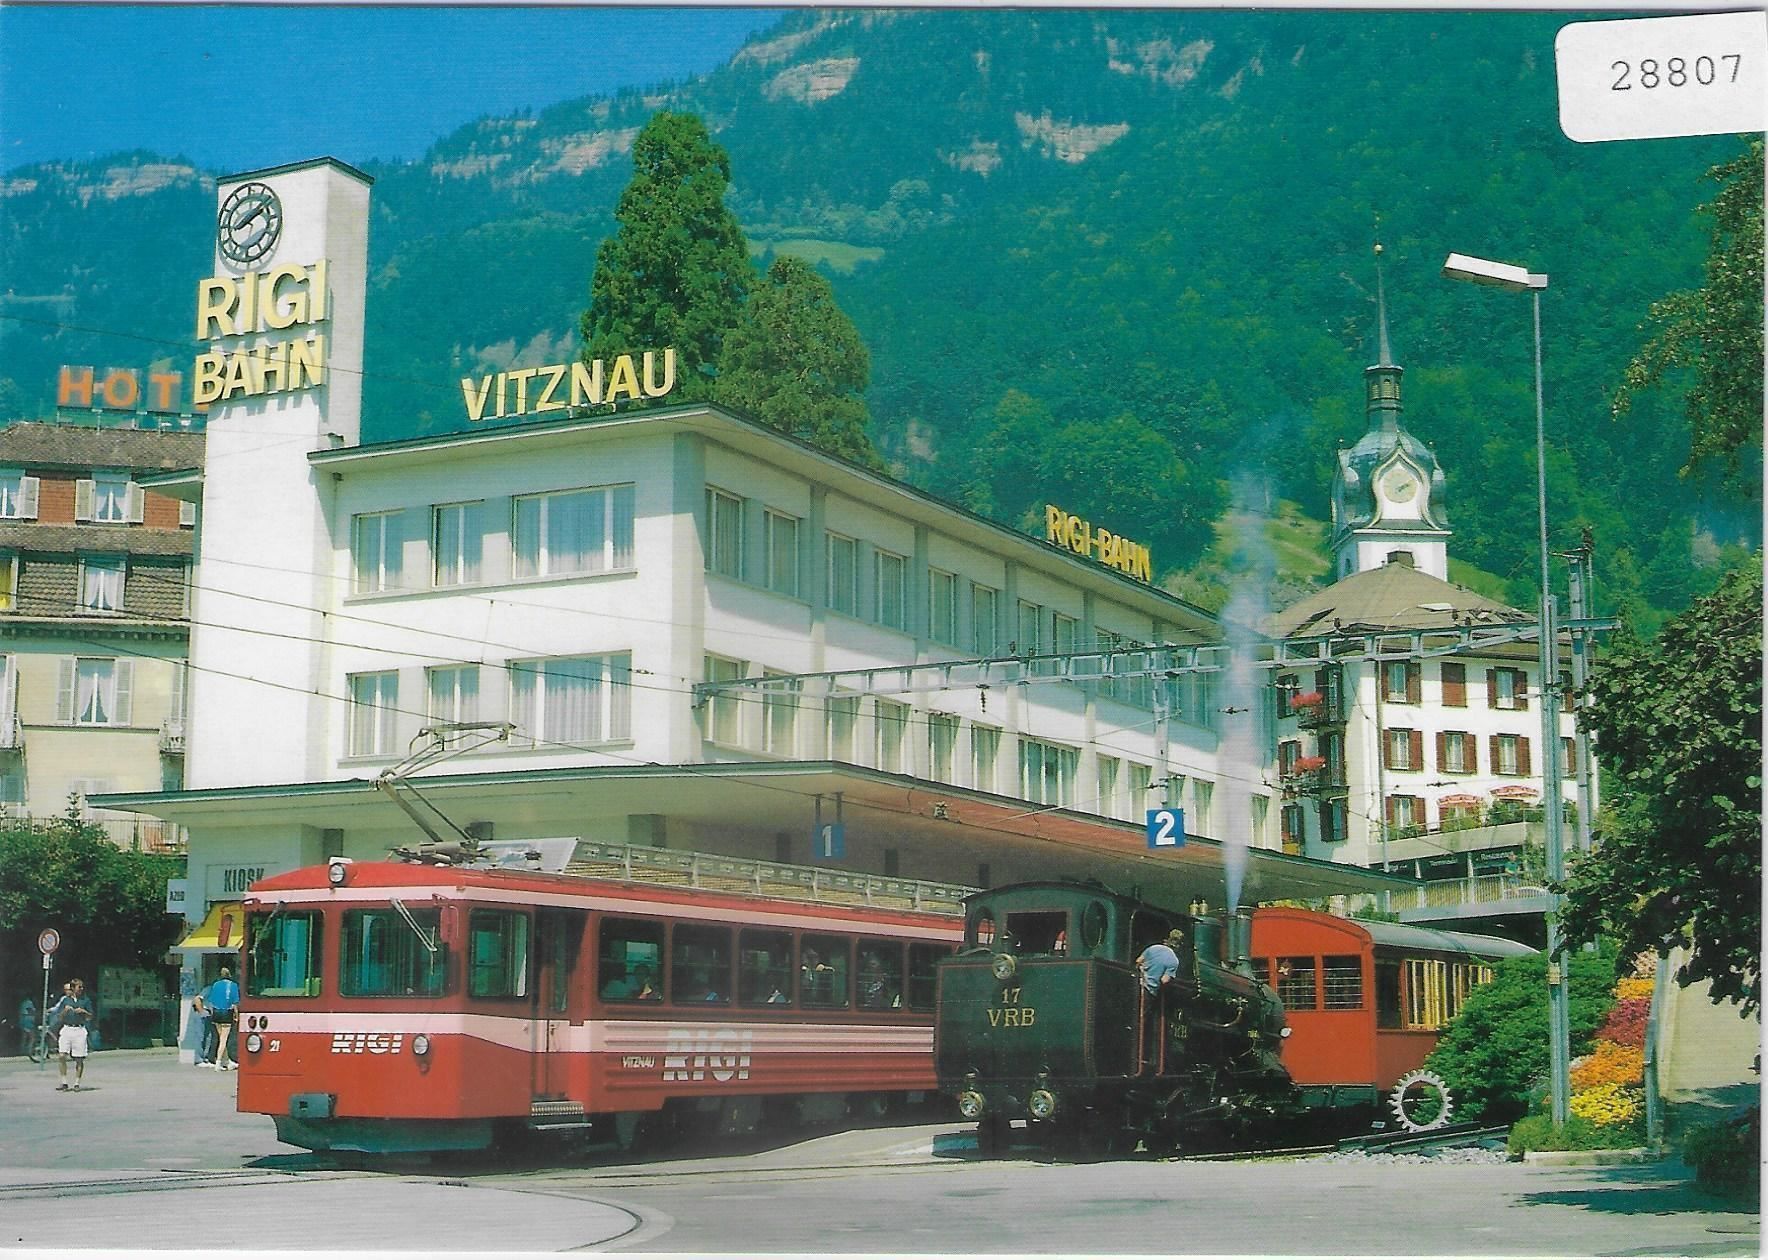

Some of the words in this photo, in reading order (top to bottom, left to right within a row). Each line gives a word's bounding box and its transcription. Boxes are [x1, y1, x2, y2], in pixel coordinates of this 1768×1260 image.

[197, 258, 331, 341] RIGI
[194, 334, 327, 405] BAHN
[461, 348, 676, 421] VITZNAU
[57, 368, 208, 412] HOT
[1045, 504, 1151, 582] RIGI-BAHN
[822, 825, 832, 857] 1
[1154, 810, 1176, 846] 2
[1001, 987, 1021, 1004] 17
[987, 1007, 1036, 1027] VRB
[269, 1040, 281, 1052] 21
[330, 1031, 403, 1054] RIGI
[622, 1056, 655, 1068] VITZNAU
[663, 1029, 753, 1082] RIGI
